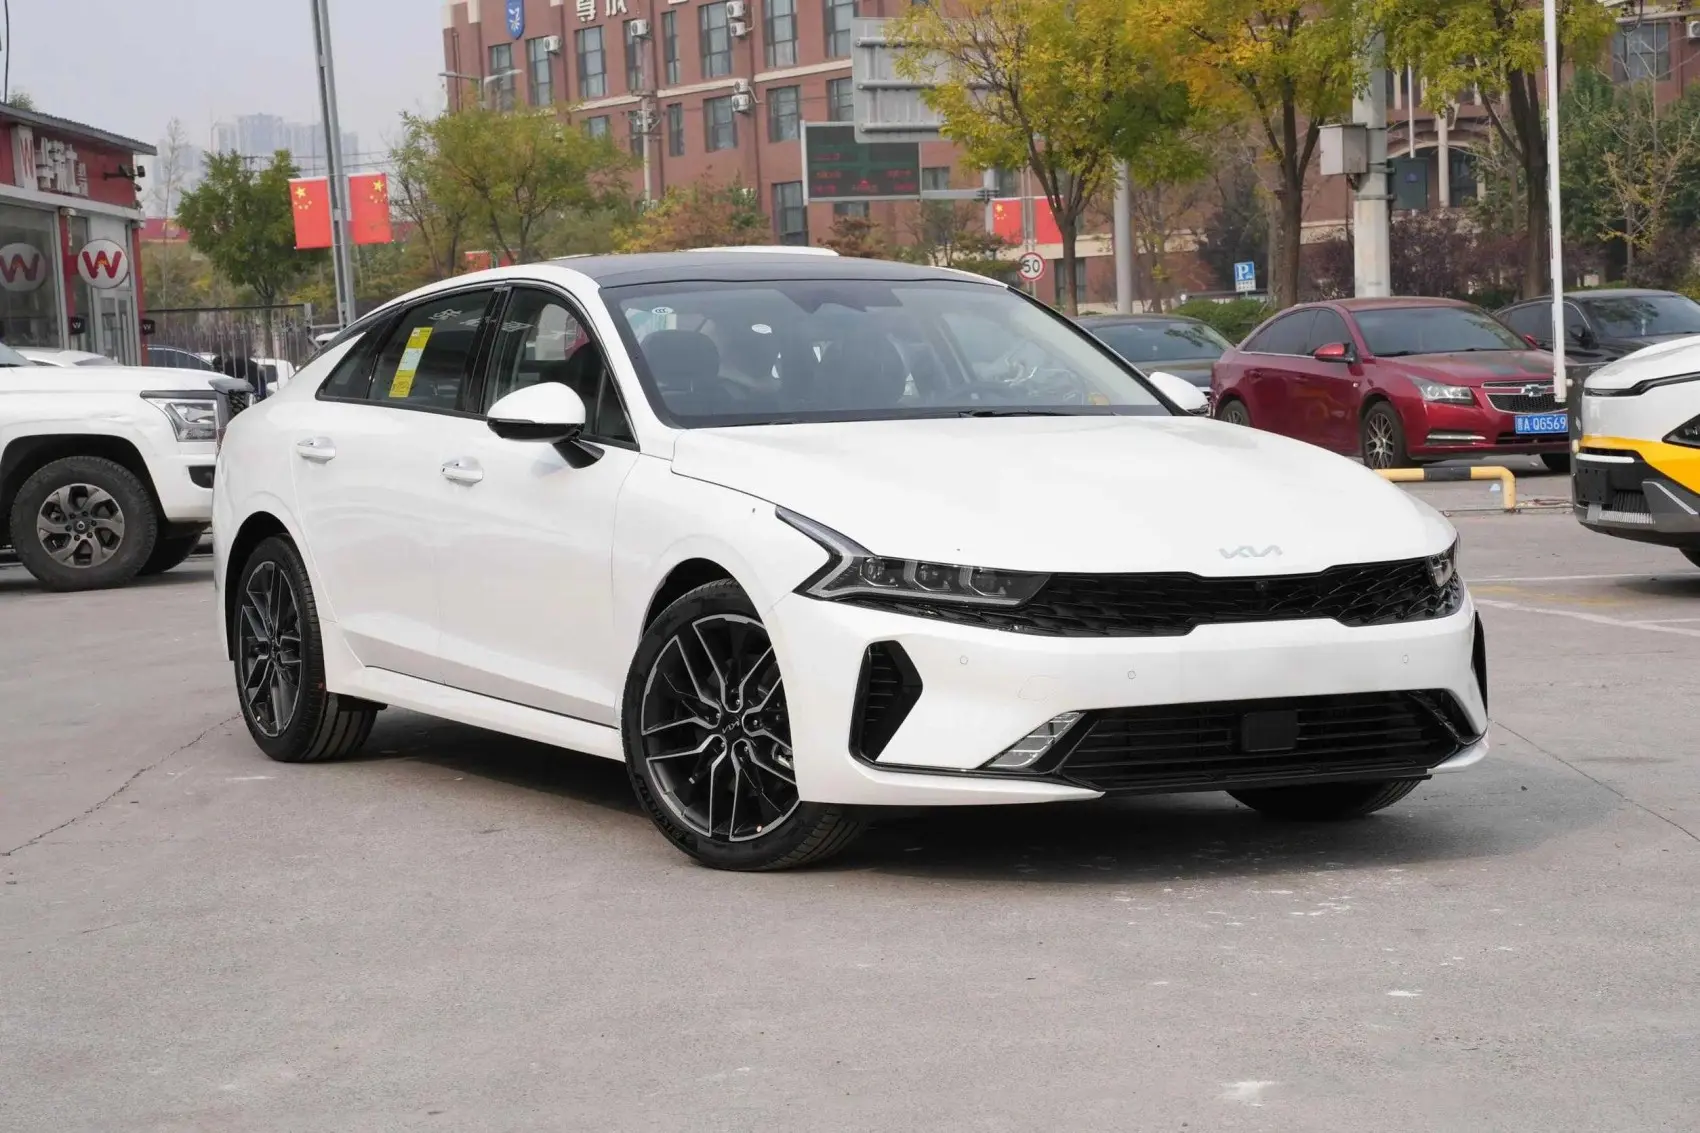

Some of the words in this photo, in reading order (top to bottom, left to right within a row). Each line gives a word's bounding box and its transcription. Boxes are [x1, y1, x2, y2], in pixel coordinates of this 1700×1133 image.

[0, 253, 40, 283] W
[82, 250, 122, 279] W
[1023, 258, 1041, 273] 50
[1237, 265, 1249, 280] P
